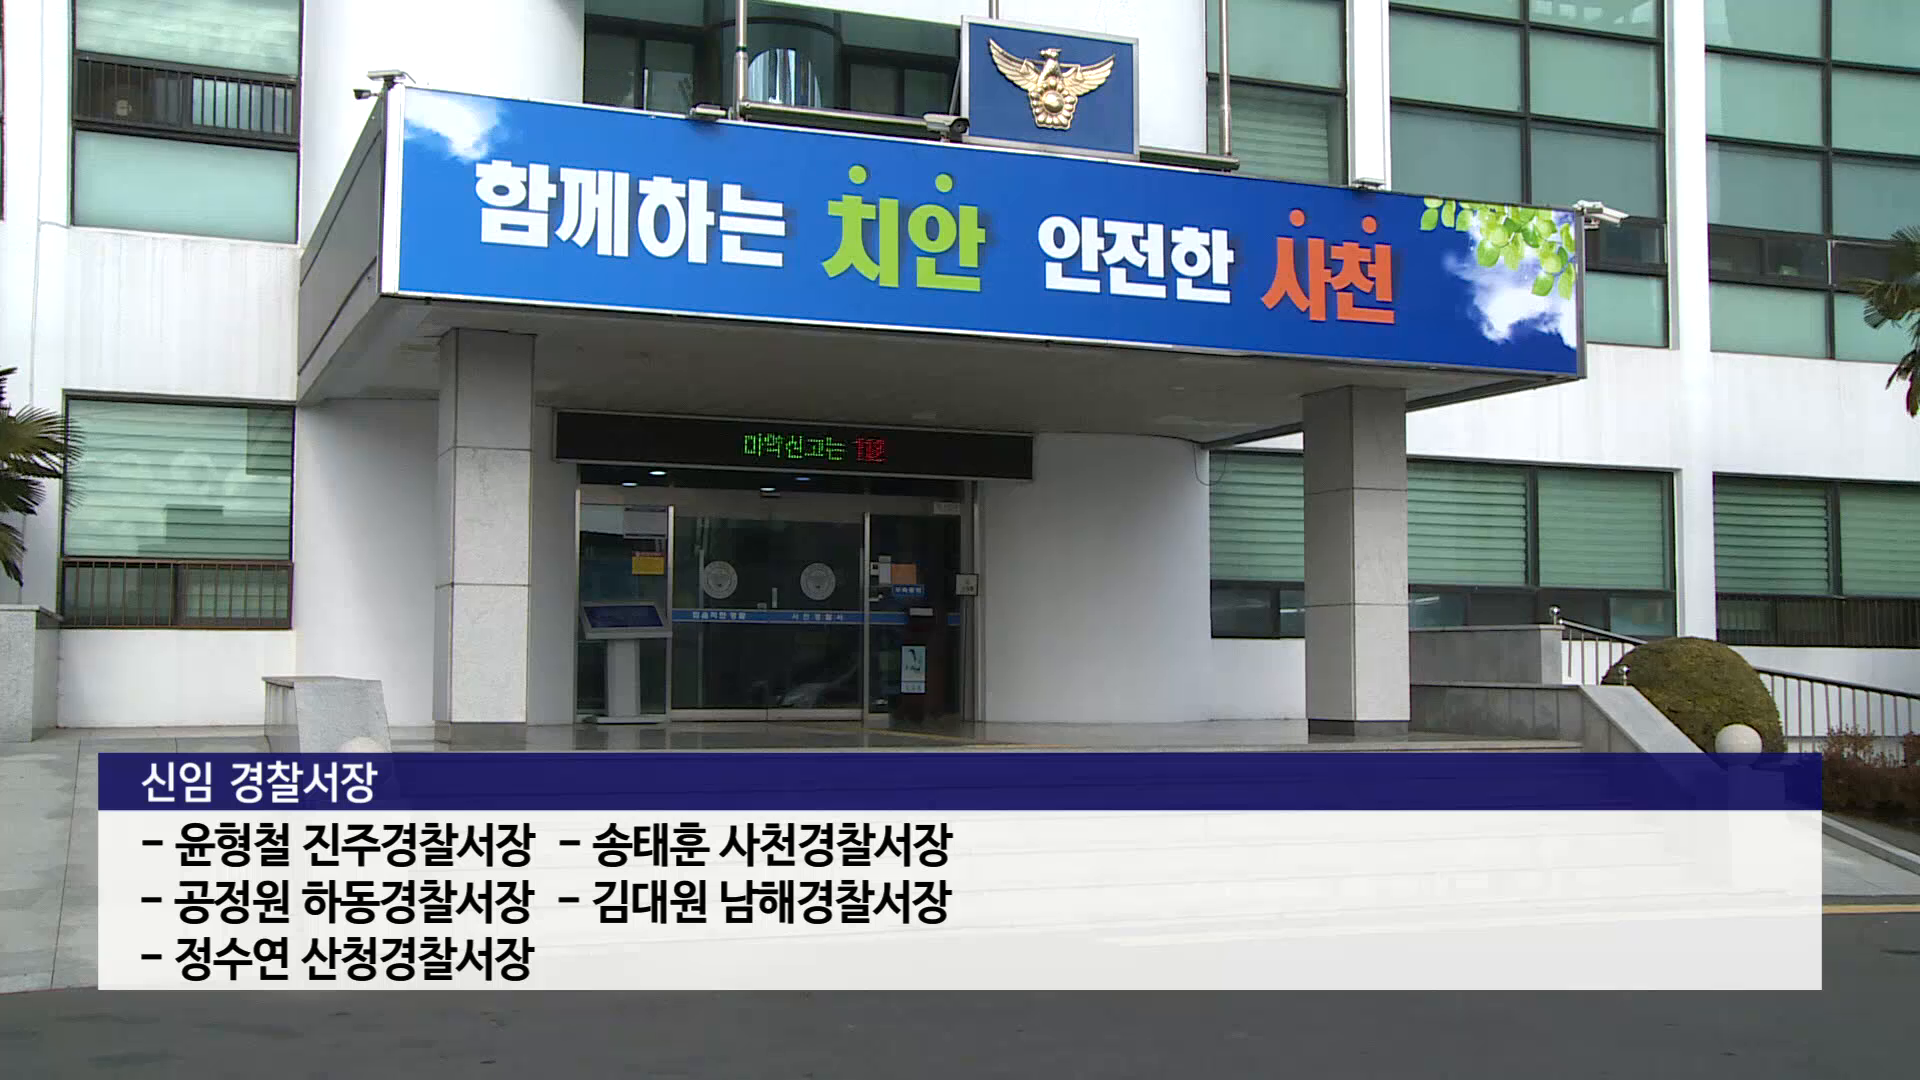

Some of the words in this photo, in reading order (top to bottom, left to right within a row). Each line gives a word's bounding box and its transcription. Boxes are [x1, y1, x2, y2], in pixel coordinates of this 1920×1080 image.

[475, 160, 786, 268] 함께하는
[822, 165, 986, 292] 치안
[1038, 215, 1235, 304] 안전한
[1261, 209, 1396, 325] 사천
[743, 432, 846, 461] 마약신고는
